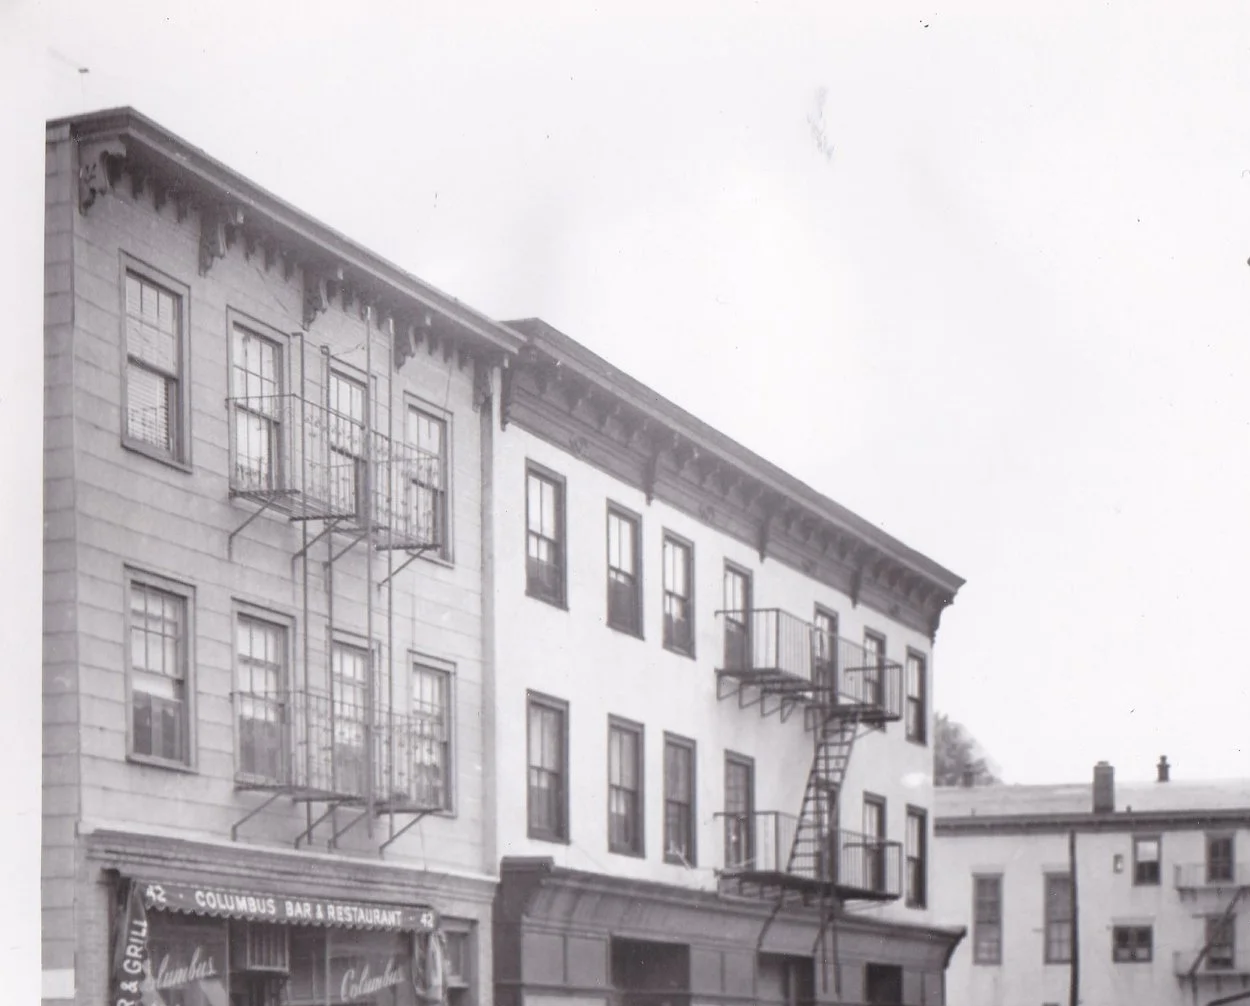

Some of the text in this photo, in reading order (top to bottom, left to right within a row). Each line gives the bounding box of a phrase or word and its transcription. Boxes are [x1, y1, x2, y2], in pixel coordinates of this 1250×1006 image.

[146, 884, 435, 929] 42 COLUMBUS BAR & RESTAURANT 42
[122, 920, 148, 974] GRILL
[119, 981, 139, 993] &
